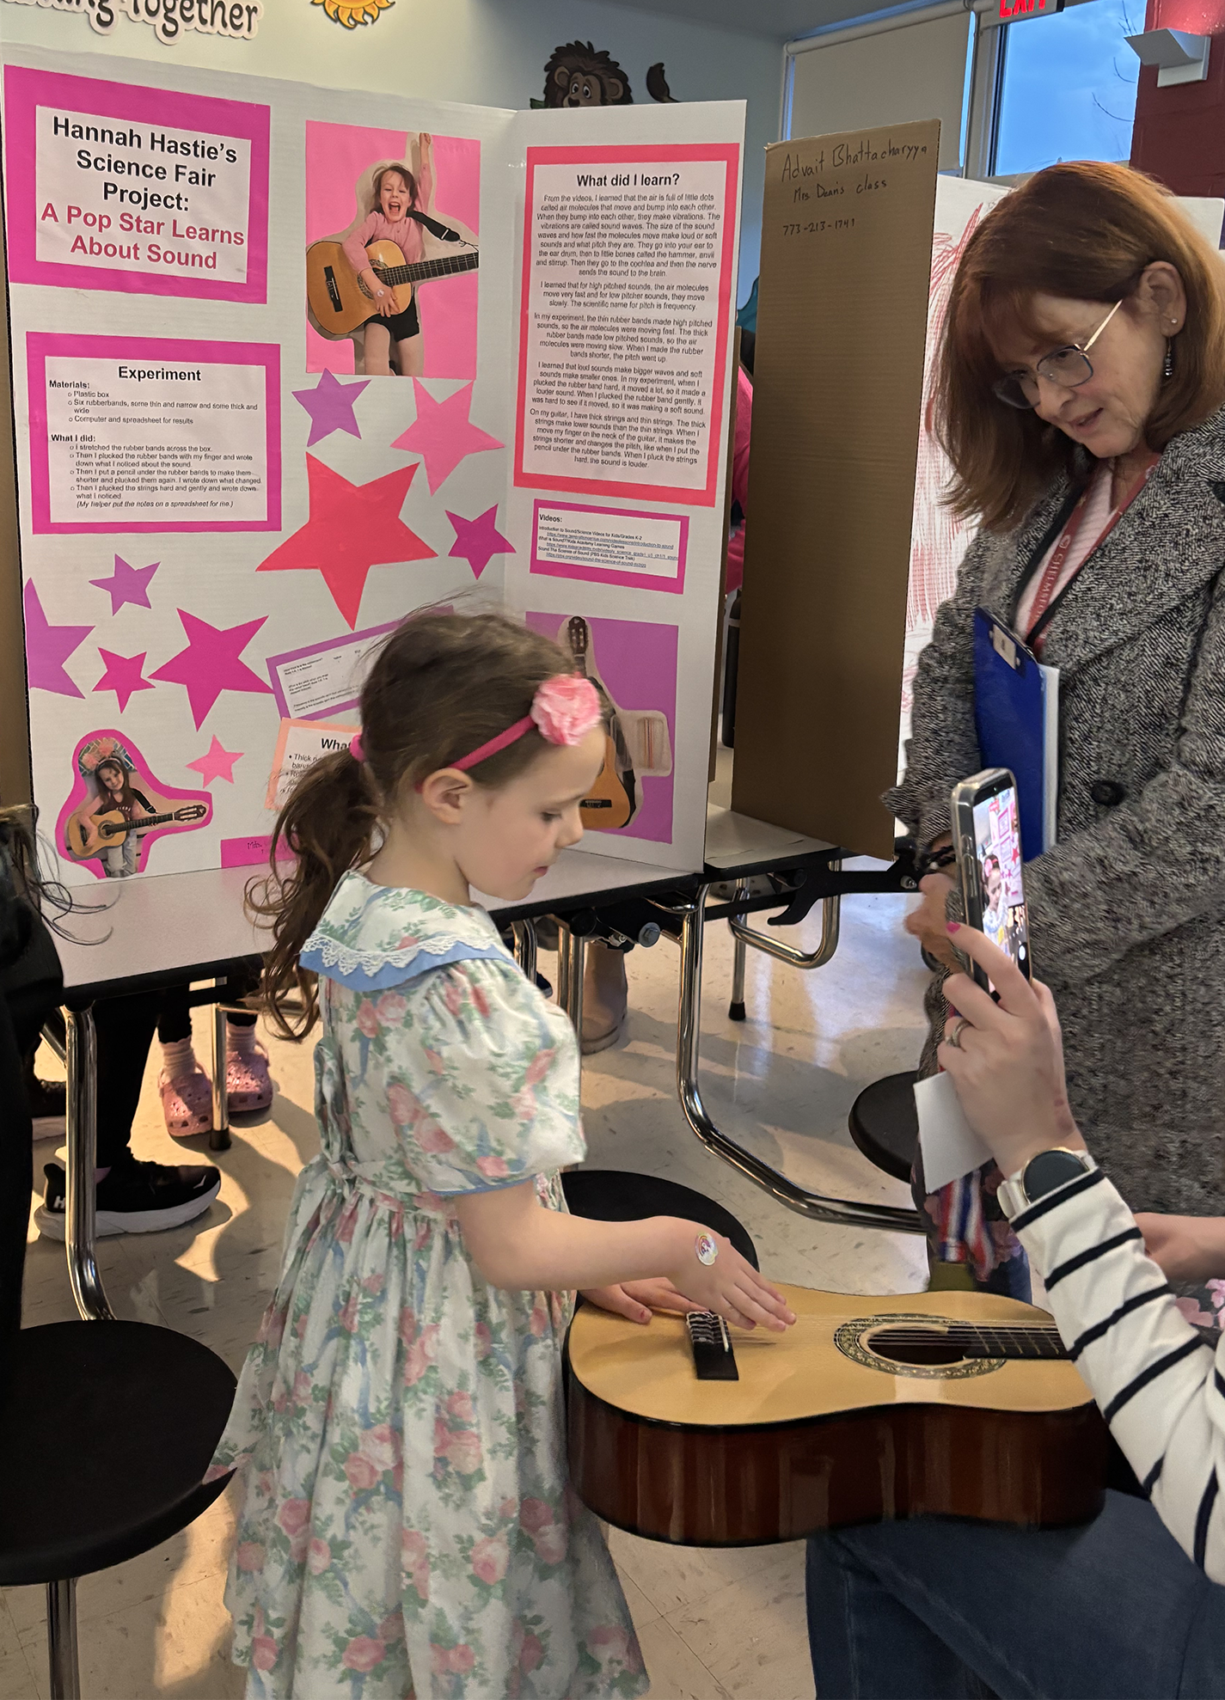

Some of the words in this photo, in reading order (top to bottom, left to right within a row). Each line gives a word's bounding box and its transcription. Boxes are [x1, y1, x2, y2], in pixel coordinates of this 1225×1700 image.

[54, 116, 142, 148] Hannah
[77, 150, 167, 179] Science
[175, 164, 216, 186] Fair
[782, 151, 824, 182] Advait
[577, 174, 606, 186] What
[611, 174, 629, 186] did
[641, 173, 680, 186] learn?
[856, 174, 887, 193] class
[104, 182, 188, 211] Project:
[41, 203, 58, 222] A
[67, 206, 111, 232] Pop
[119, 212, 165, 235] Star
[173, 219, 244, 245] Learns
[70, 235, 140, 260] About
[147, 244, 217, 269] Sound
[118, 366, 201, 382] Experiment
[49, 380, 90, 389] Materials:
[74, 416, 106, 424] Computer
[122, 417, 161, 425] spreadsheet
[98, 452, 123, 461] plucked
[204, 454, 221, 462] finger
[98, 469, 109, 477] put
[116, 469, 135, 477] pencil
[114, 476, 139, 485] plucked
[98, 484, 124, 493] plucked
[137, 485, 158, 493] strings
[188, 485, 207, 493] gently
[540, 514, 562, 523] Videos:
[321, 738, 352, 750] Wha
